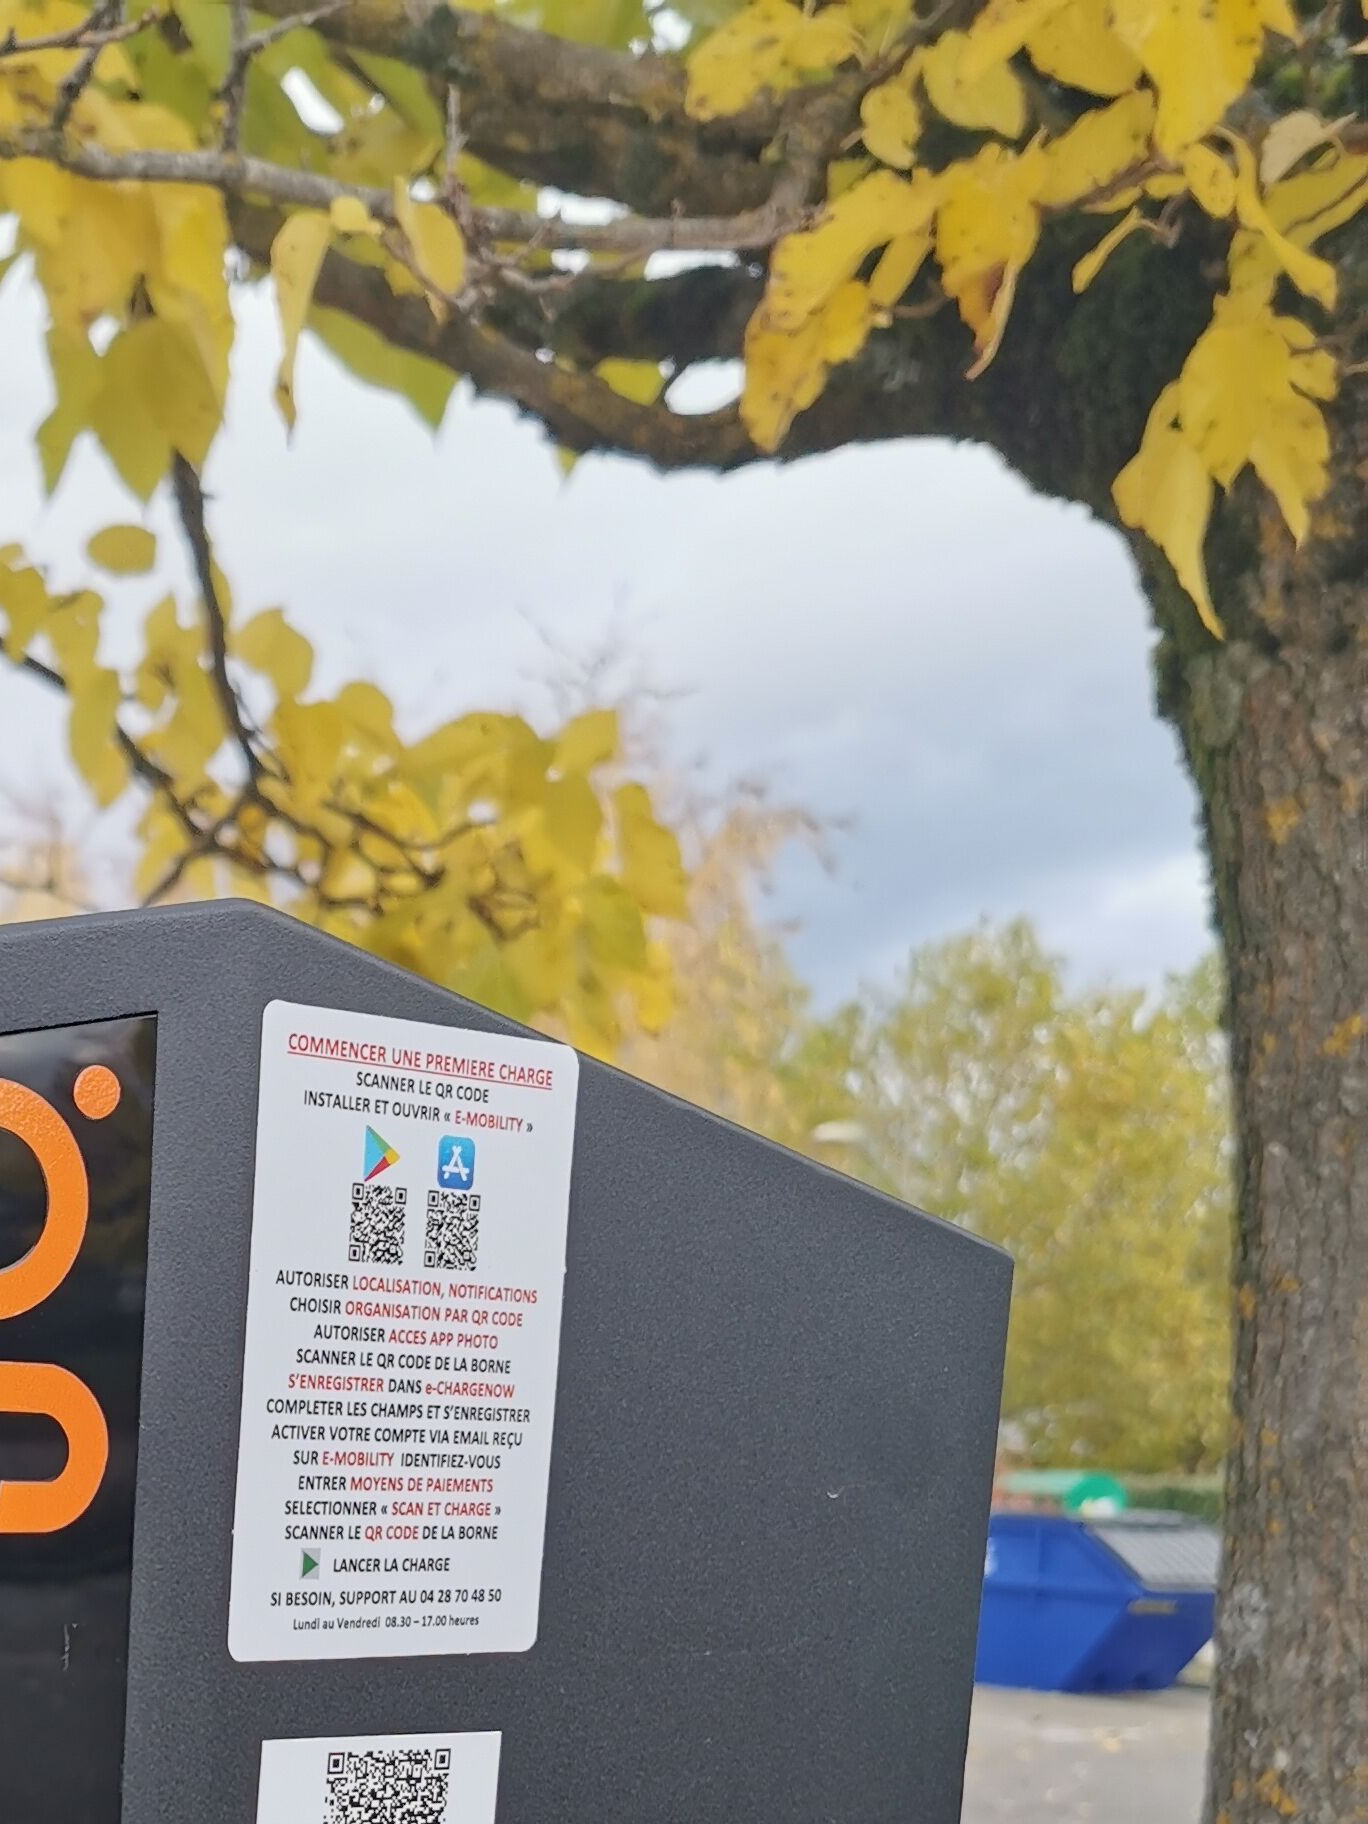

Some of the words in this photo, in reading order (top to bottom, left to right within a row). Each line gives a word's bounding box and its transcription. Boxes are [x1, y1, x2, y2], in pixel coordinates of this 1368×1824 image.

[287, 1033, 387, 1063] COMMENCER
[392, 1048, 421, 1067] UNE
[426, 1053, 495, 1078] PREMIERE
[499, 1064, 553, 1086] CHARGE
[356, 1071, 415, 1093] SCANNER
[419, 1080, 432, 1095] LE
[436, 1082, 452, 1098] QR
[457, 1084, 489, 1103] CODE
[303, 1090, 370, 1112] INSTALLER
[375, 1099, 388, 1115] ET
[392, 1101, 440, 1122] OUVRIR
[455, 1110, 523, 1133] E-MOBILITY
[275, 1270, 348, 1289] AUTORISER
[353, 1276, 445, 1298] LOCALISATION,
[448, 1283, 537, 1304] NOTIFICATIONS
[290, 1297, 341, 1314] CHOISIR
[345, 1301, 441, 1321] ORGANISATION
[445, 1307, 468, 1323] PAR
[471, 1309, 488, 1326] QR
[492, 1310, 523, 1327] CODE
[313, 1324, 385, 1342] AUTORISER
[389, 1329, 426, 1345] ACCES
[430, 1331, 453, 1346] APP
[457, 1333, 498, 1349] PHOTO
[296, 1349, 356, 1367] SCANNER
[360, 1353, 373, 1367] LE
[376, 1354, 394, 1370] QR
[398, 1355, 431, 1371] CODE
[435, 1357, 450, 1371] DE
[454, 1358, 467, 1372] LA
[471, 1359, 511, 1374] BORNE
[388, 1380, 422, 1394] DANS
[425, 1381, 515, 1398] e-CHARGENOW
[266, 1399, 344, 1415] COMPLETER
[347, 1402, 367, 1417] LES
[370, 1403, 423, 1419] CHAMPS
[427, 1405, 441, 1419] ET
[271, 1425, 325, 1440] ACTIVER
[329, 1427, 370, 1441] VOTRE
[374, 1428, 426, 1444] COMPTE
[429, 1430, 450, 1444] VIA
[454, 1431, 489, 1445] EMAIL
[492, 1433, 522, 1449] REÇU
[293, 1451, 319, 1466] SUR
[322, 1452, 394, 1467] E-MOBILITY
[401, 1453, 501, 1469] IDENTIFIEZ-VOUS
[298, 1476, 347, 1491] ENTRER
[350, 1477, 404, 1491] MOYENS
[407, 1478, 423, 1492] DE
[427, 1478, 493, 1492] PAIEMENTS
[284, 1501, 377, 1516] SELECTIONNER
[391, 1502, 424, 1516] SCAN
[427, 1502, 442, 1516] ET
[444, 1502, 492, 1517] CHARGE
[284, 1526, 344, 1540] SCANNER
[348, 1526, 361, 1540] LE
[365, 1526, 383, 1542] QR
[386, 1526, 419, 1540] CODE
[423, 1527, 438, 1540] DE
[441, 1526, 455, 1540] LA
[458, 1526, 498, 1540] BORNE
[333, 1558, 381, 1573] LANCER
[384, 1558, 398, 1573] LA
[402, 1558, 451, 1573] CHARGE
[270, 1592, 282, 1607] SI
[286, 1592, 336, 1608] BESOIN,
[340, 1590, 397, 1606] SUPPORT
[400, 1590, 417, 1605] AU
[420, 1590, 435, 1603] 04
[437, 1590, 452, 1603] 28
[454, 1589, 468, 1603] 70
[471, 1589, 486, 1602] 48
[488, 1589, 502, 1602] 50
[293, 1618, 319, 1631] Lundi
[322, 1619, 334, 1630] au
[337, 1617, 381, 1629] Vendredi
[385, 1617, 411, 1628] 08.30
[422, 1616, 447, 1627] 17.00
[449, 1615, 480, 1627] heures
